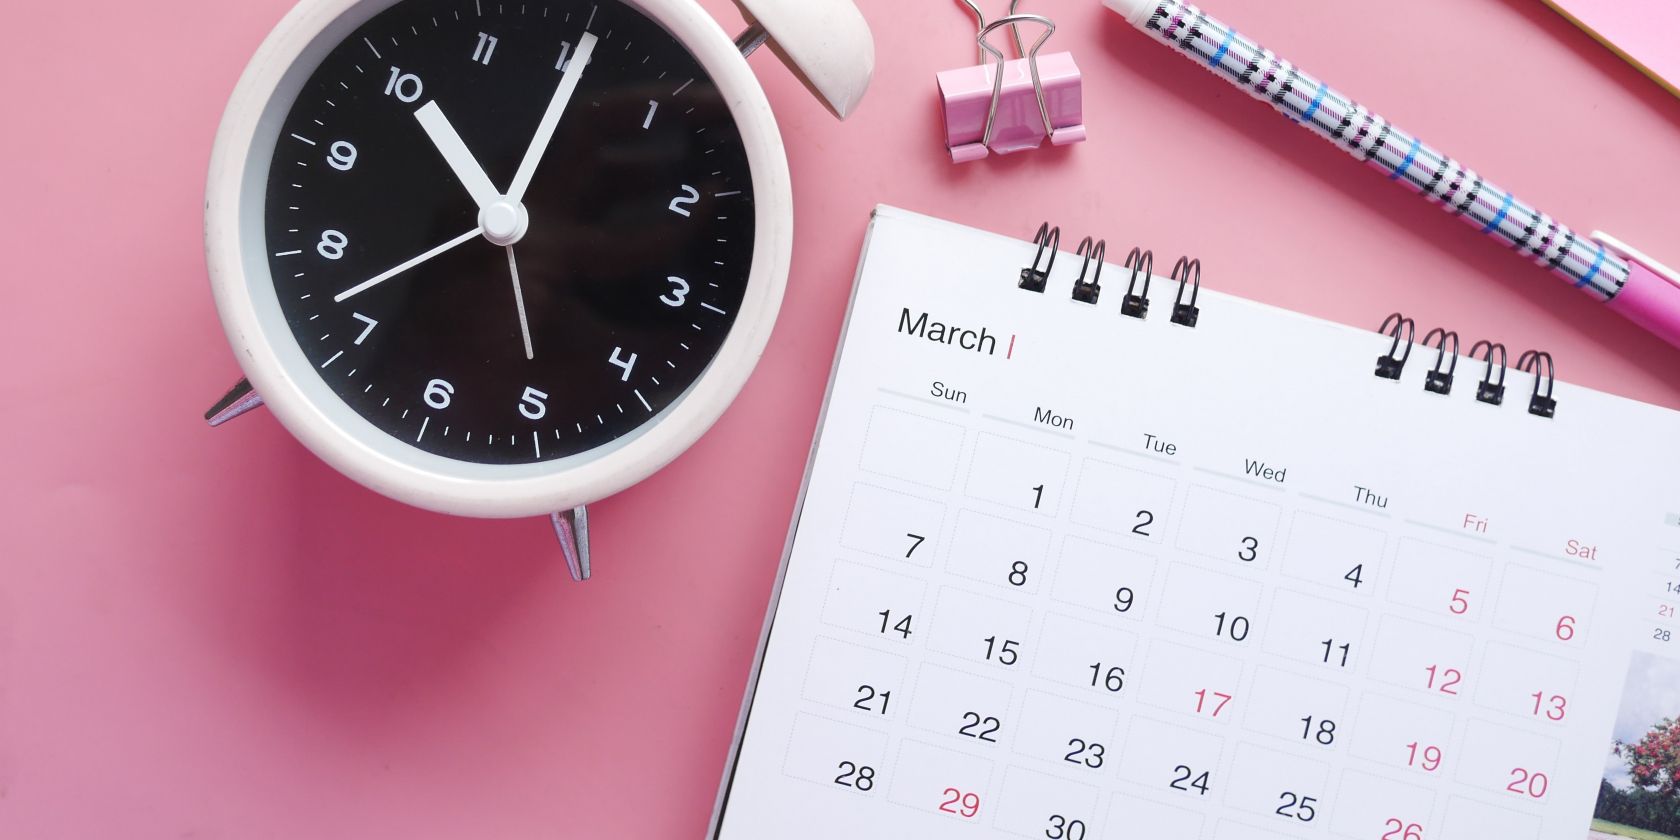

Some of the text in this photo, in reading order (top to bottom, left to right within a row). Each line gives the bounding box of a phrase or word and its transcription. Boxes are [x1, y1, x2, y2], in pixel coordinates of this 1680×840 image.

[471, 31, 498, 66] 11
[384, 65, 423, 103] 10
[642, 100, 659, 130] 1
[326, 140, 358, 171] 9
[668, 184, 700, 217] 2
[316, 229, 349, 260] 8
[659, 276, 690, 307] 3
[352, 311, 379, 346] 7
[897, 307, 996, 356] March
[608, 346, 638, 382] 4
[423, 378, 455, 410] 6
[518, 385, 549, 420] 5
[930, 381, 1597, 561] Sun Mon Tue Wed Thu Fri Sat
[1032, 484, 1576, 641] 1 2 3 4 5 6
[905, 533, 1567, 721] 7 8 9 10 11 12 13
[1657, 604, 1674, 618] 21
[1653, 627, 1671, 642] 28
[878, 609, 1548, 799] 14 15 16 17 18 19 20
[853, 684, 1423, 840] 21 22 23 24 25 26
[834, 760, 1086, 840] 28 29 30
